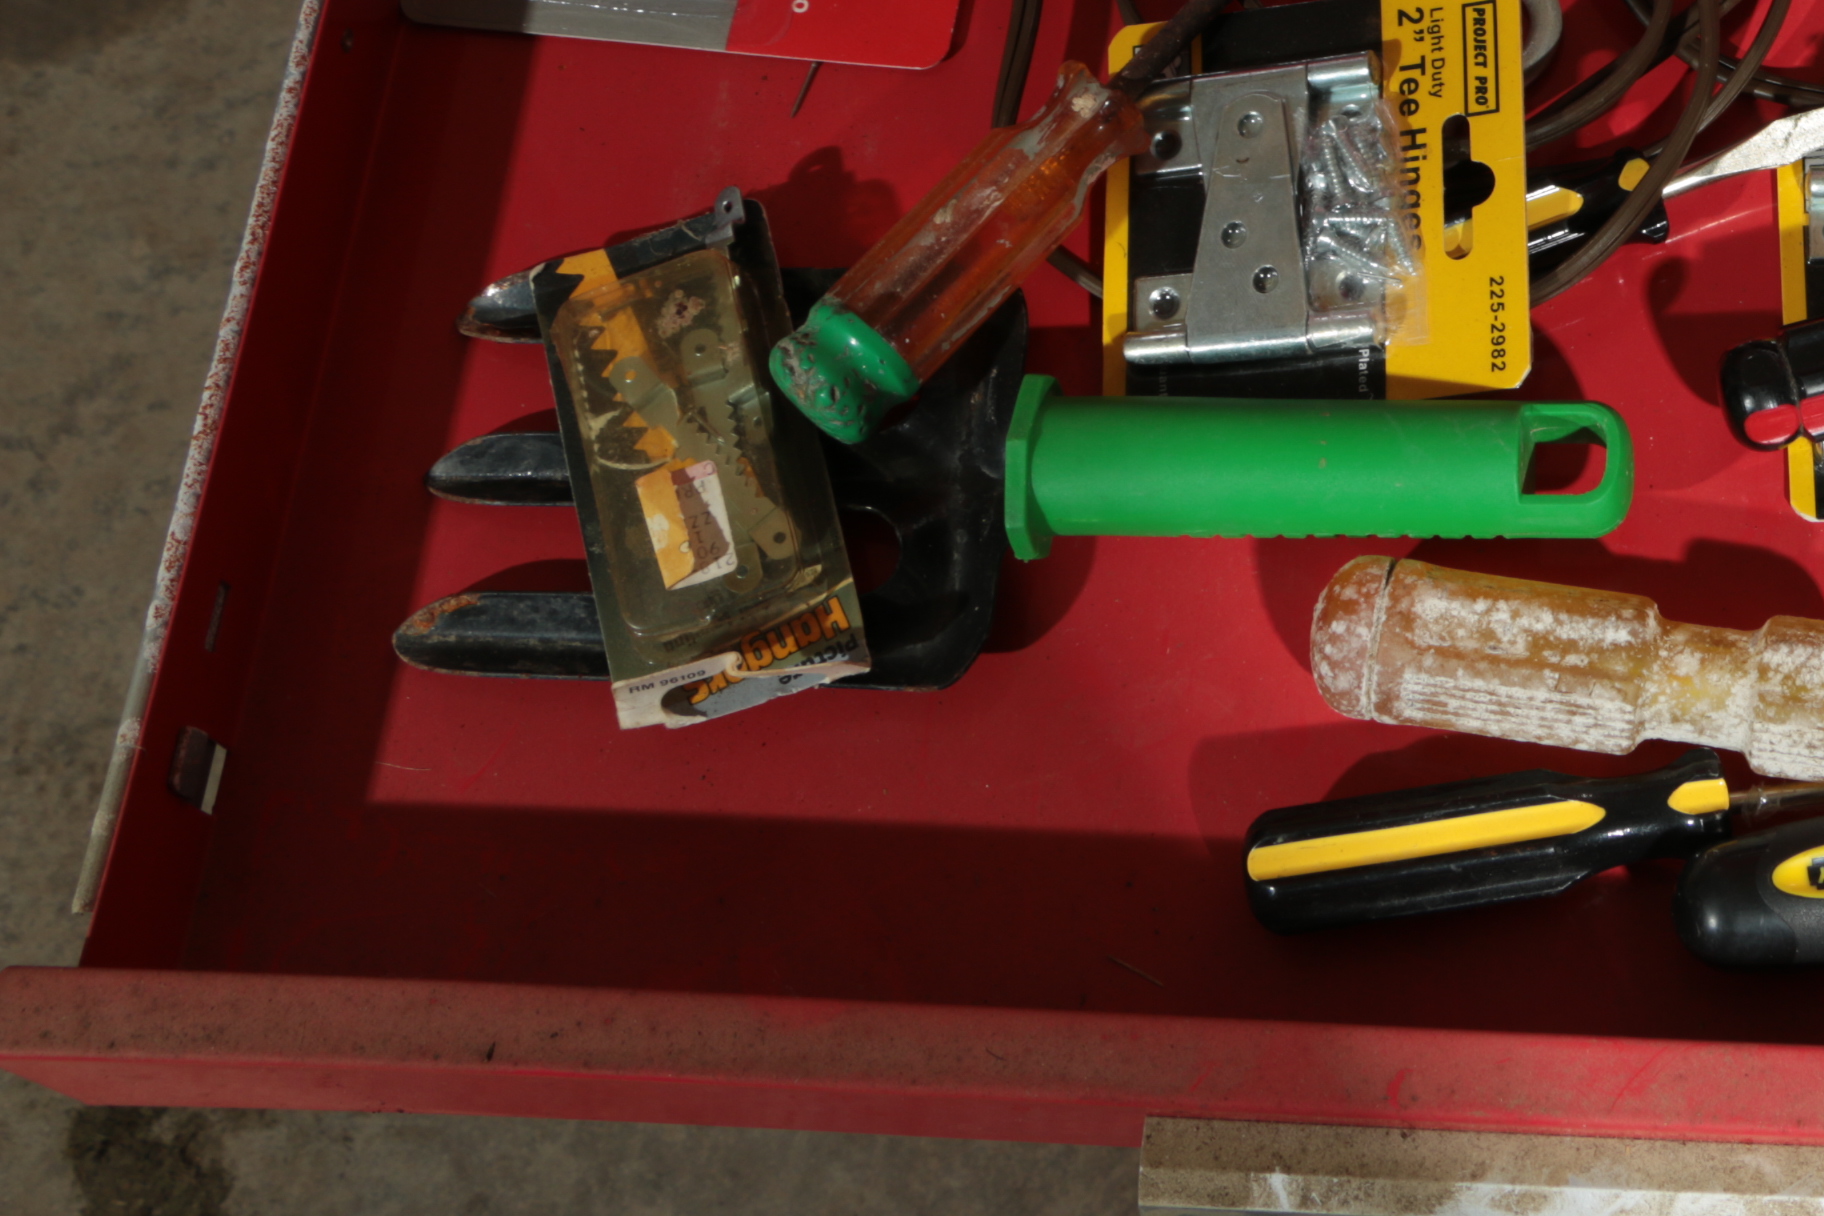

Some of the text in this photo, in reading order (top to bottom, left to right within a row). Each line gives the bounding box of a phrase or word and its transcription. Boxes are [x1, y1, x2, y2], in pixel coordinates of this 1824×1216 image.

[1398, 54, 1427, 118] Tee
[1426, 5, 1446, 99] Light Duty
[1471, 6, 1490, 107] PROJECT PRO
[1399, 127, 1429, 251] Hinges
[1357, 347, 1371, 394] Plated
[1488, 274, 1508, 374] 225-2982
[626, 667, 707, 695] RM 96109
